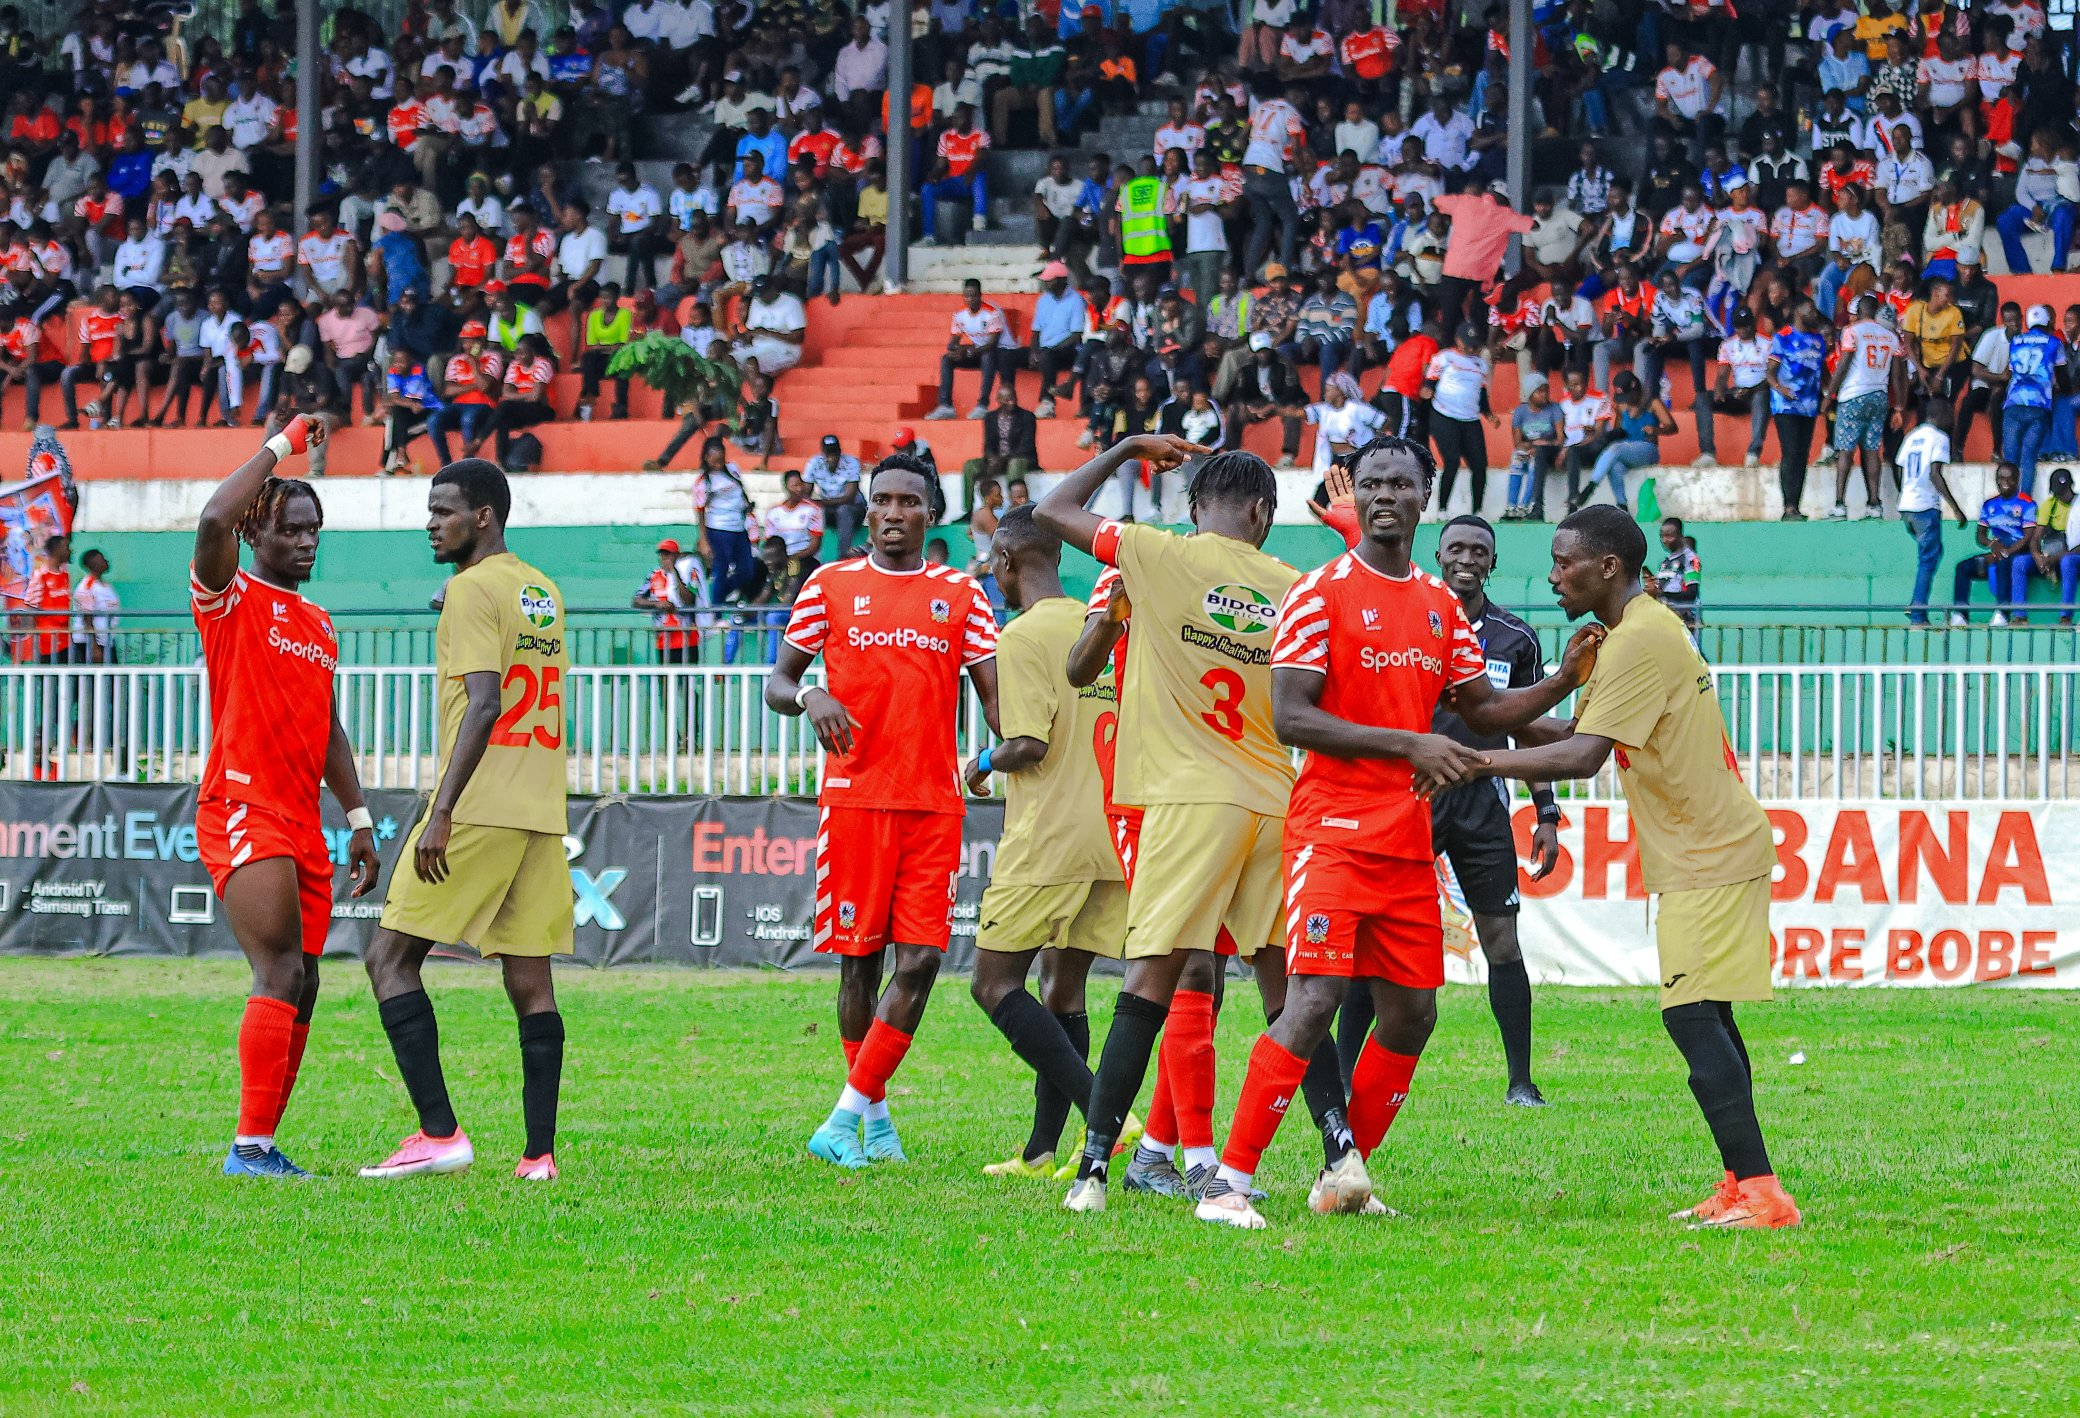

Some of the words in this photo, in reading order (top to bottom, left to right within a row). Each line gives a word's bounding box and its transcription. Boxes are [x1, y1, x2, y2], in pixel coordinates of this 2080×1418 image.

[1207, 593, 1276, 618] BIDCO
[1217, 606, 1263, 622] AFRICA
[847, 626, 949, 654] SportPesa
[1218, 637, 1253, 663] Healthy
[1360, 646, 1443, 677] SportPesa
[1488, 662, 1508, 675] FIFA
[488, 664, 562, 751] 25
[1199, 667, 1247, 743] 3
[1511, 804, 2053, 907] SHBANA
[31, 899, 90, 918] Samsung
[92, 902, 130, 915] Tizen
[330, 902, 384, 919] ax.com
[754, 925, 812, 940] Android
[1298, 951, 1319, 959] FINIX
[1770, 927, 1866, 980] RE
[1885, 928, 2058, 982] BOBE
